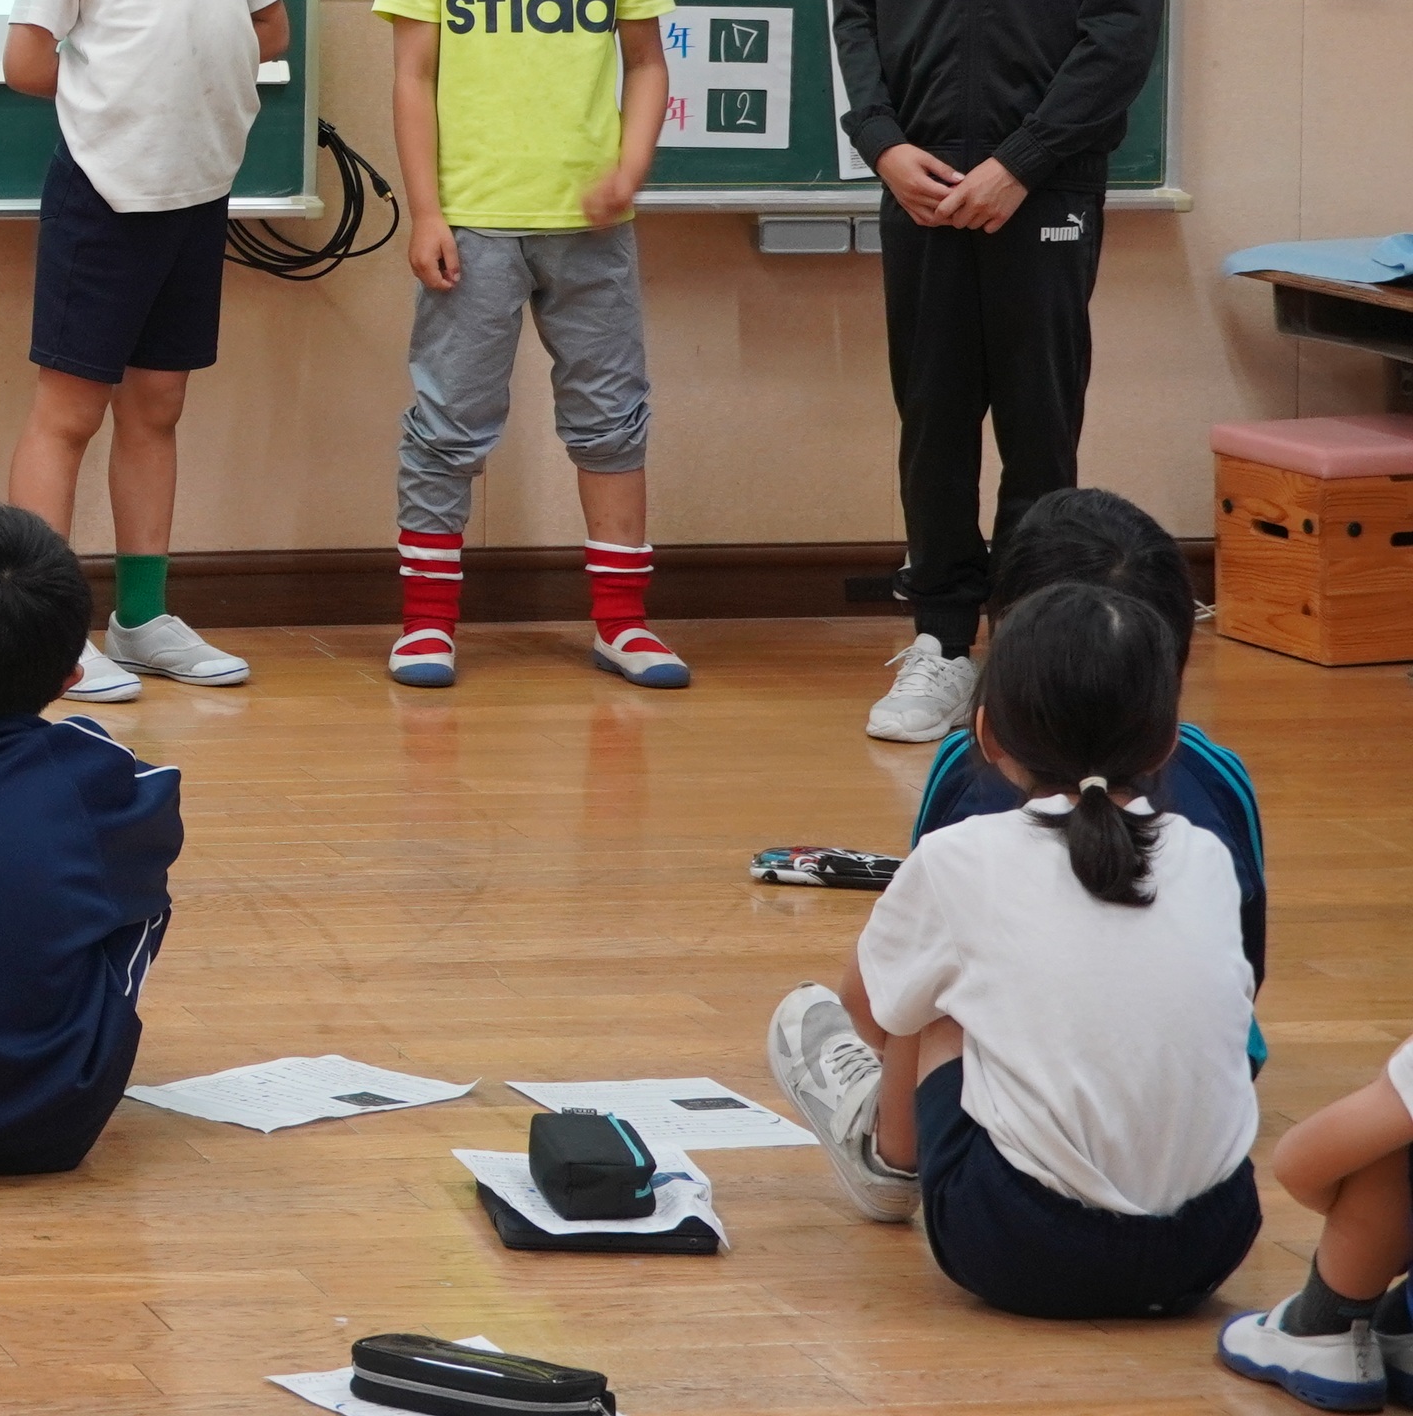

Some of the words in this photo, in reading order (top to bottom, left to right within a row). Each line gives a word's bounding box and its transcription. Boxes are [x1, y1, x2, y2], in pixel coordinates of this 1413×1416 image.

[658, 22, 696, 59] 年
[720, 23, 759, 62] 17
[720, 91, 757, 126] 12
[1040, 225, 1079, 242] PUMA
